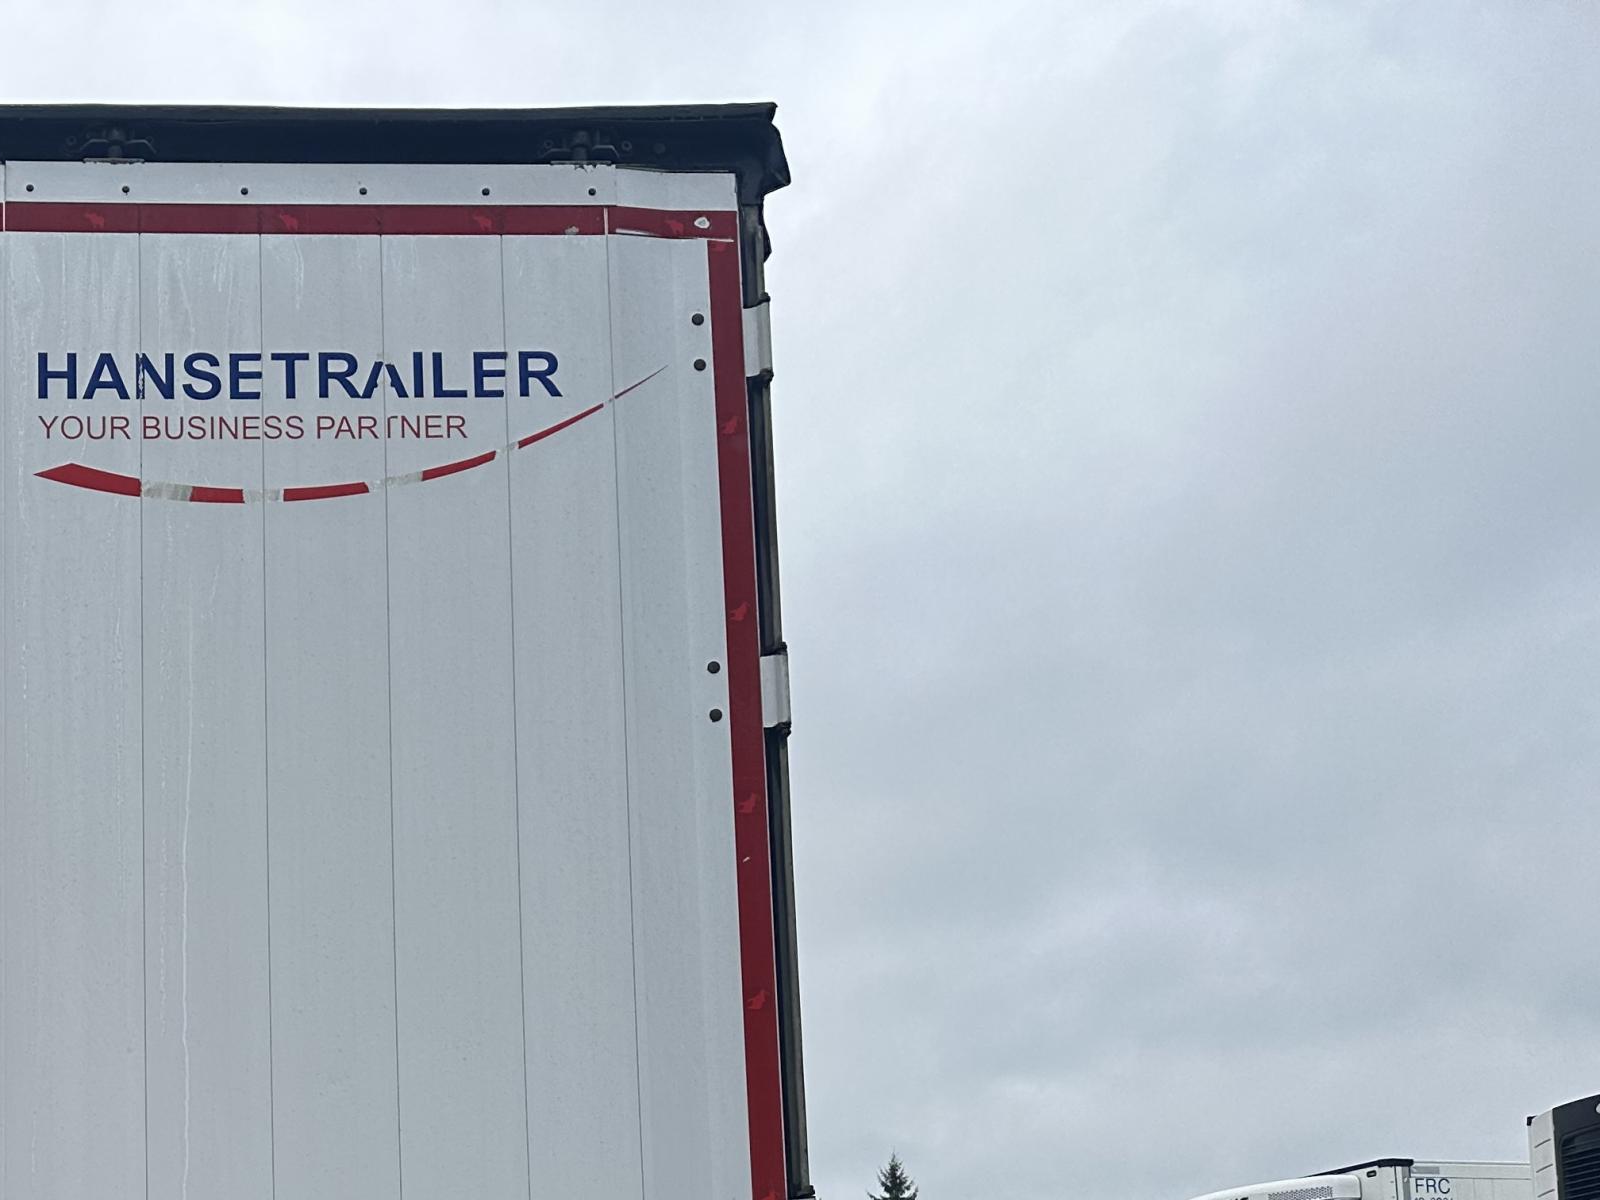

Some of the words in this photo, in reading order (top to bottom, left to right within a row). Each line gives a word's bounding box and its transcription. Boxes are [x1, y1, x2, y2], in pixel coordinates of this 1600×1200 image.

[37, 351, 562, 400] HANSETRAILER
[38, 415, 131, 440] YOUR
[143, 415, 304, 440] BUSINESS
[317, 415, 467, 440] PARTNER
[1415, 1178, 1451, 1194] FRC
